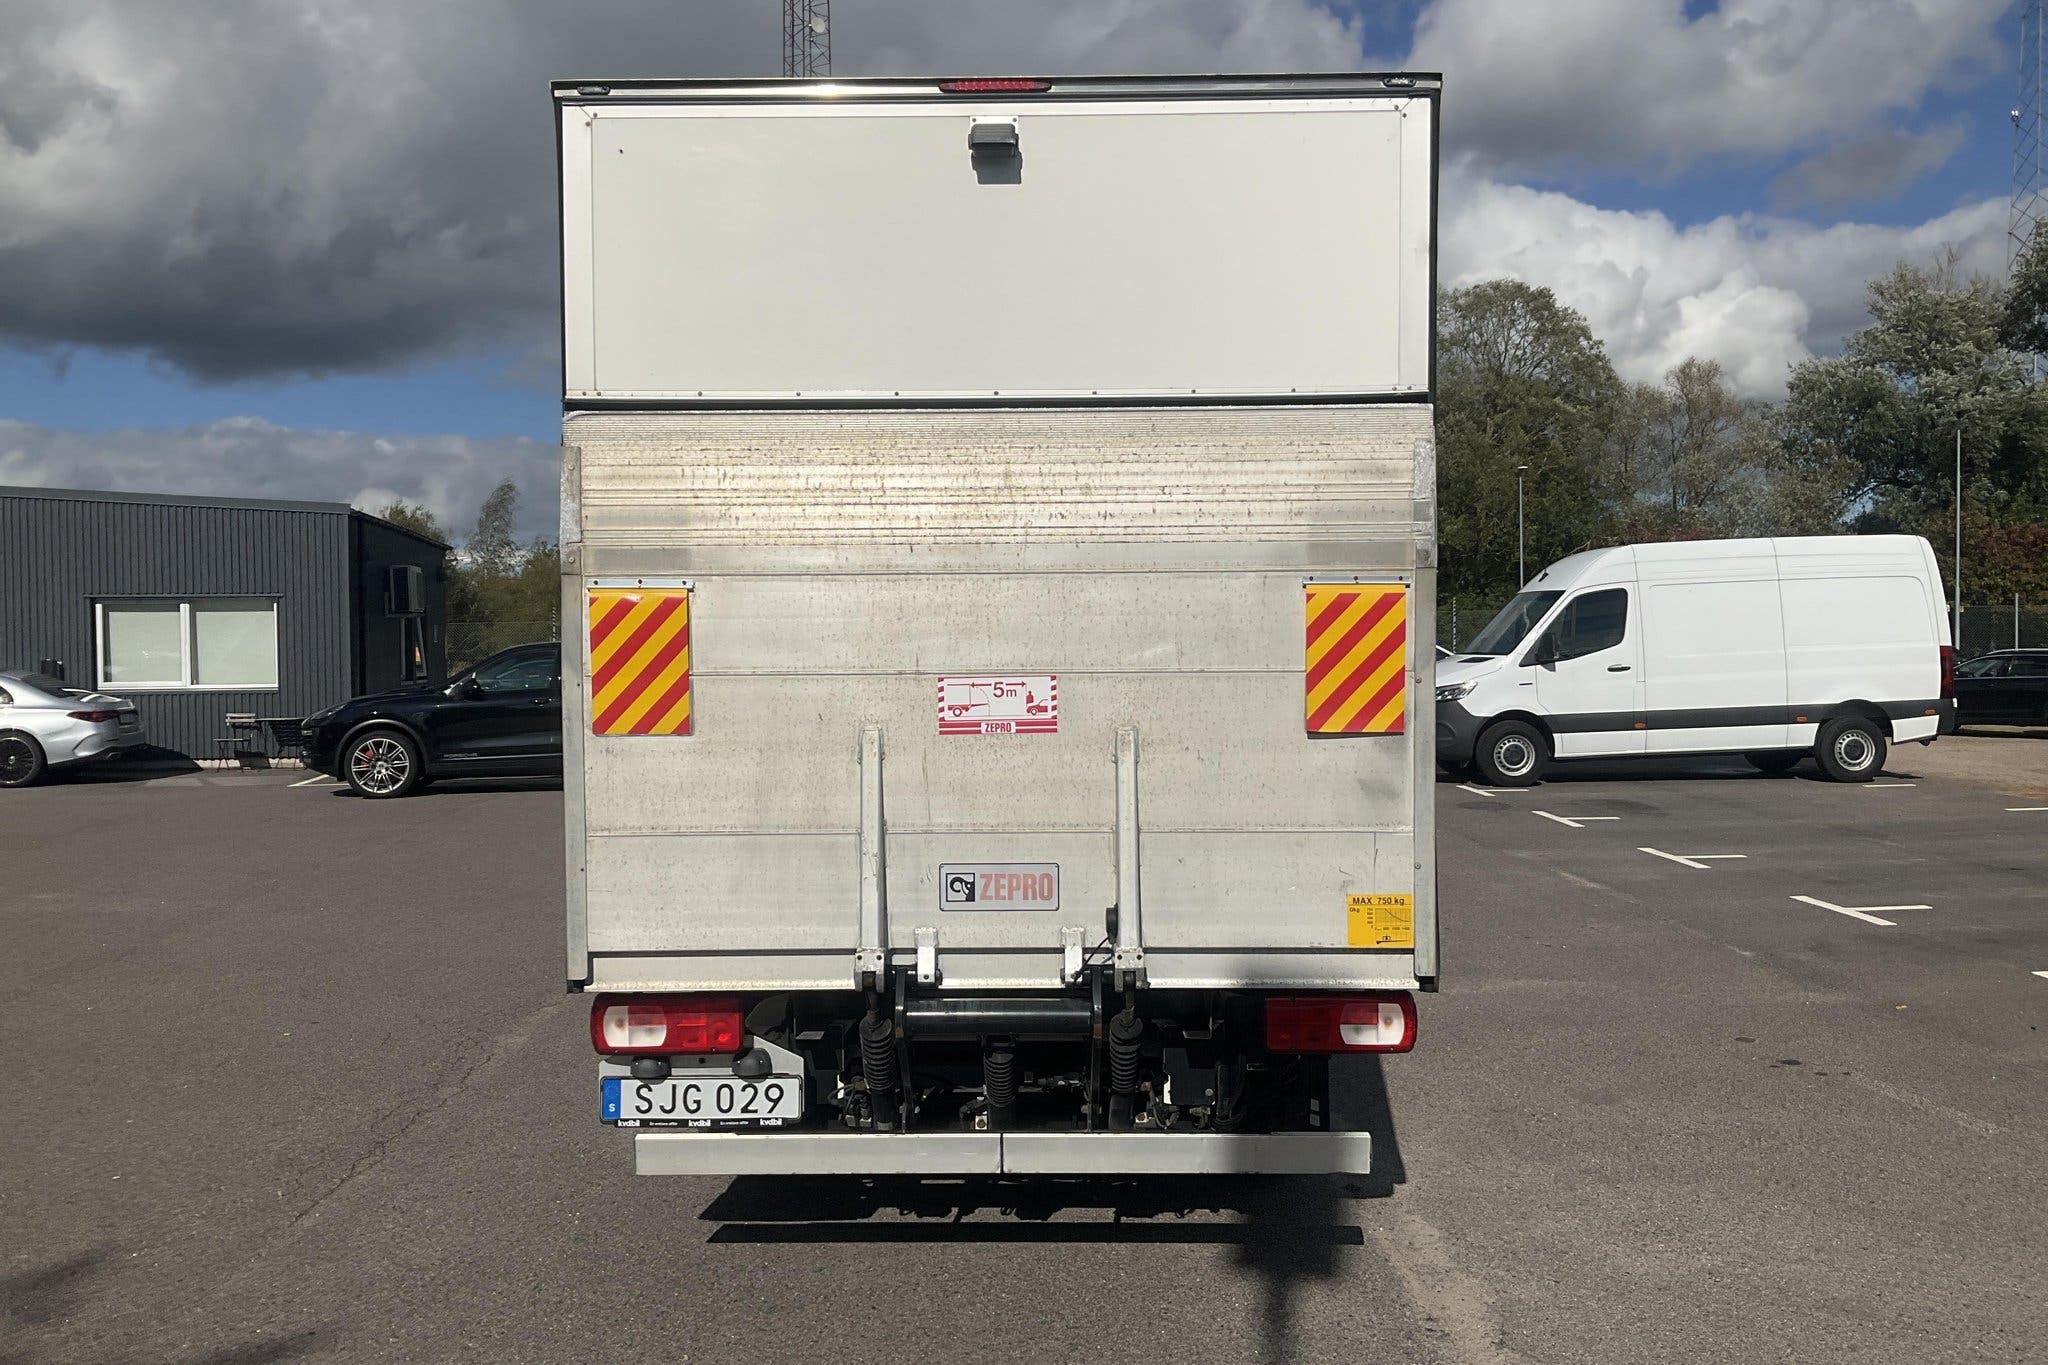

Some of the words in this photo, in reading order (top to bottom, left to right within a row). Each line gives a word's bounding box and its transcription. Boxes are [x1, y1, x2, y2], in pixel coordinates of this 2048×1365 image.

[984, 722, 1012, 733] ZEPRO
[979, 872, 1054, 901] ZEPRO
[1352, 897, 1373, 905] MAX
[1377, 897, 1392, 905] 750
[1394, 897, 1405, 906] kg
[635, 1083, 702, 1114] SJG
[716, 1083, 785, 1114] 029
[608, 1103, 616, 1113] S
[617, 1119, 641, 1127] kvdbil
[688, 1119, 711, 1127] kvdbil
[760, 1118, 783, 1126] kvdbil
